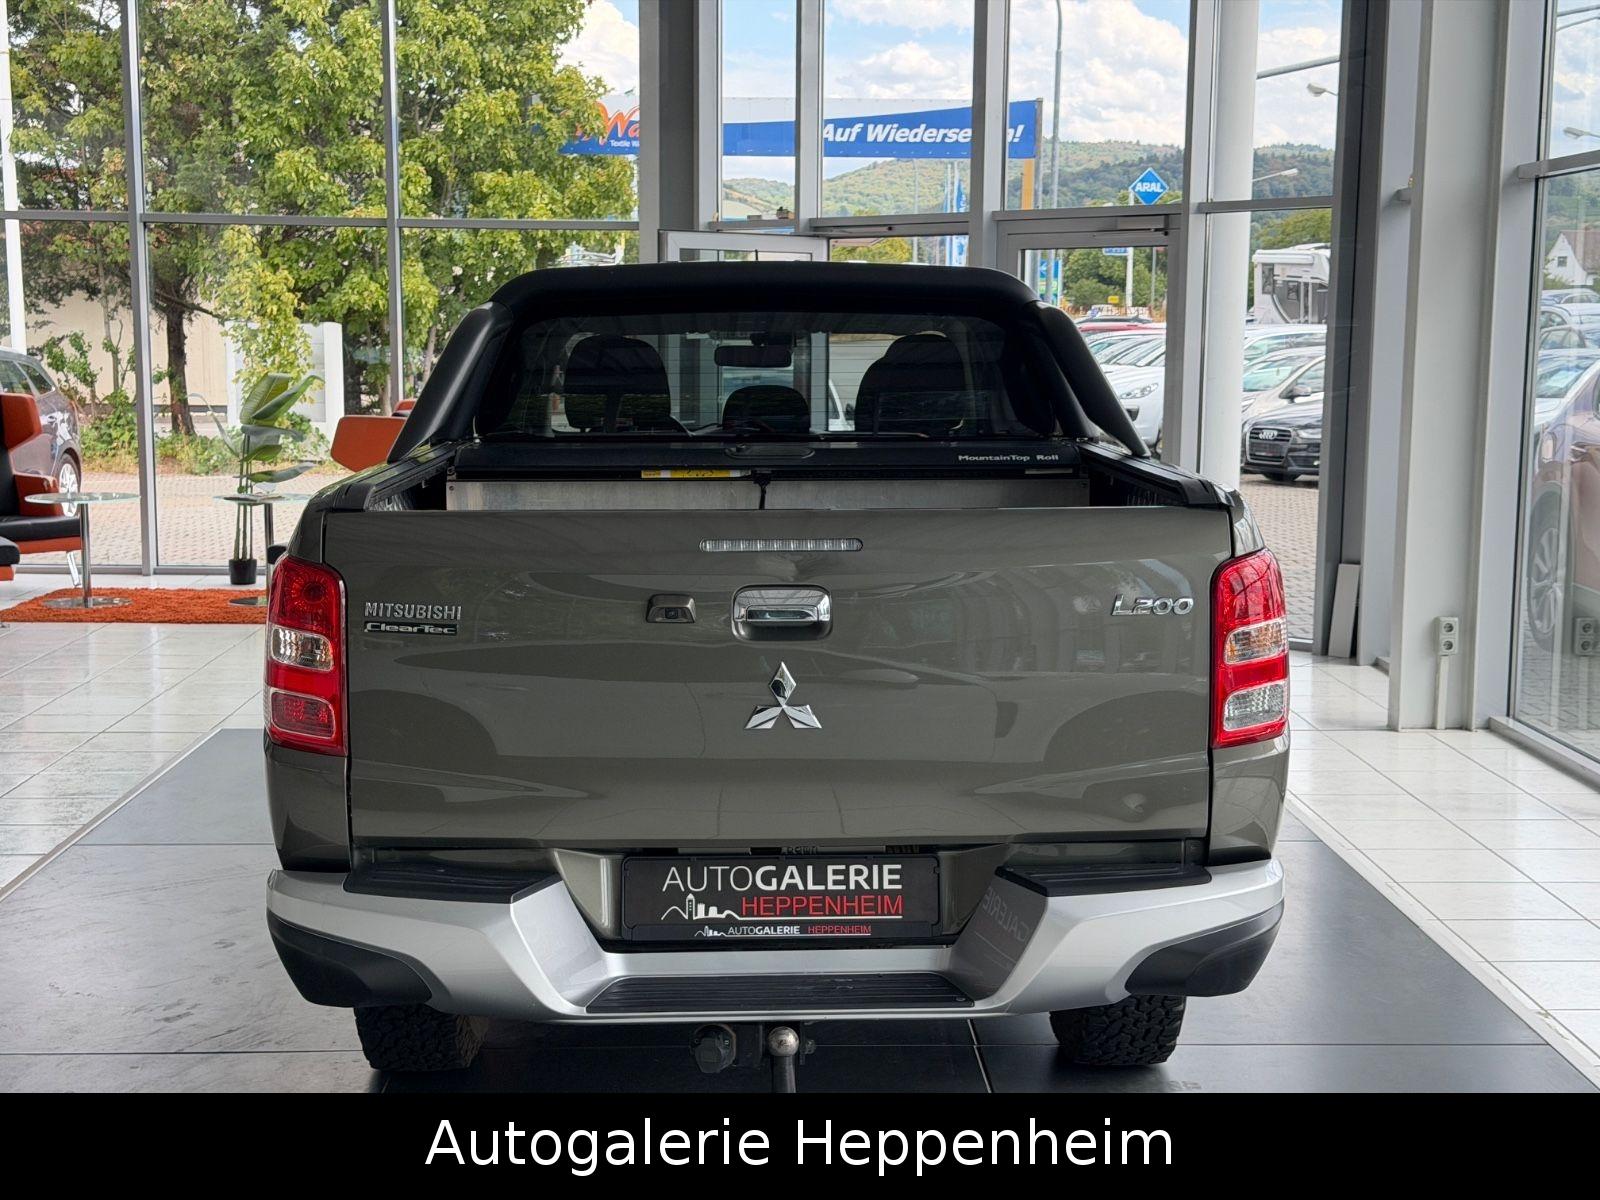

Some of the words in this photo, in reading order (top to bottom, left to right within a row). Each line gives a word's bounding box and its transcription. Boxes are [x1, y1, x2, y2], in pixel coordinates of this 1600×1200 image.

[823, 123, 862, 142] Auf
[1134, 181, 1164, 193] ARAL
[958, 454, 1031, 462] MountainTop
[364, 602, 462, 620] MITSUBISHI
[1111, 594, 1194, 616] L200
[364, 622, 456, 634] ClearTec
[662, 864, 903, 892] AUTOGALERIE
[741, 895, 903, 916] HEPPENHEIM
[728, 925, 801, 935] AUTOGALERIE
[808, 925, 872, 935] HEPPENHEIM
